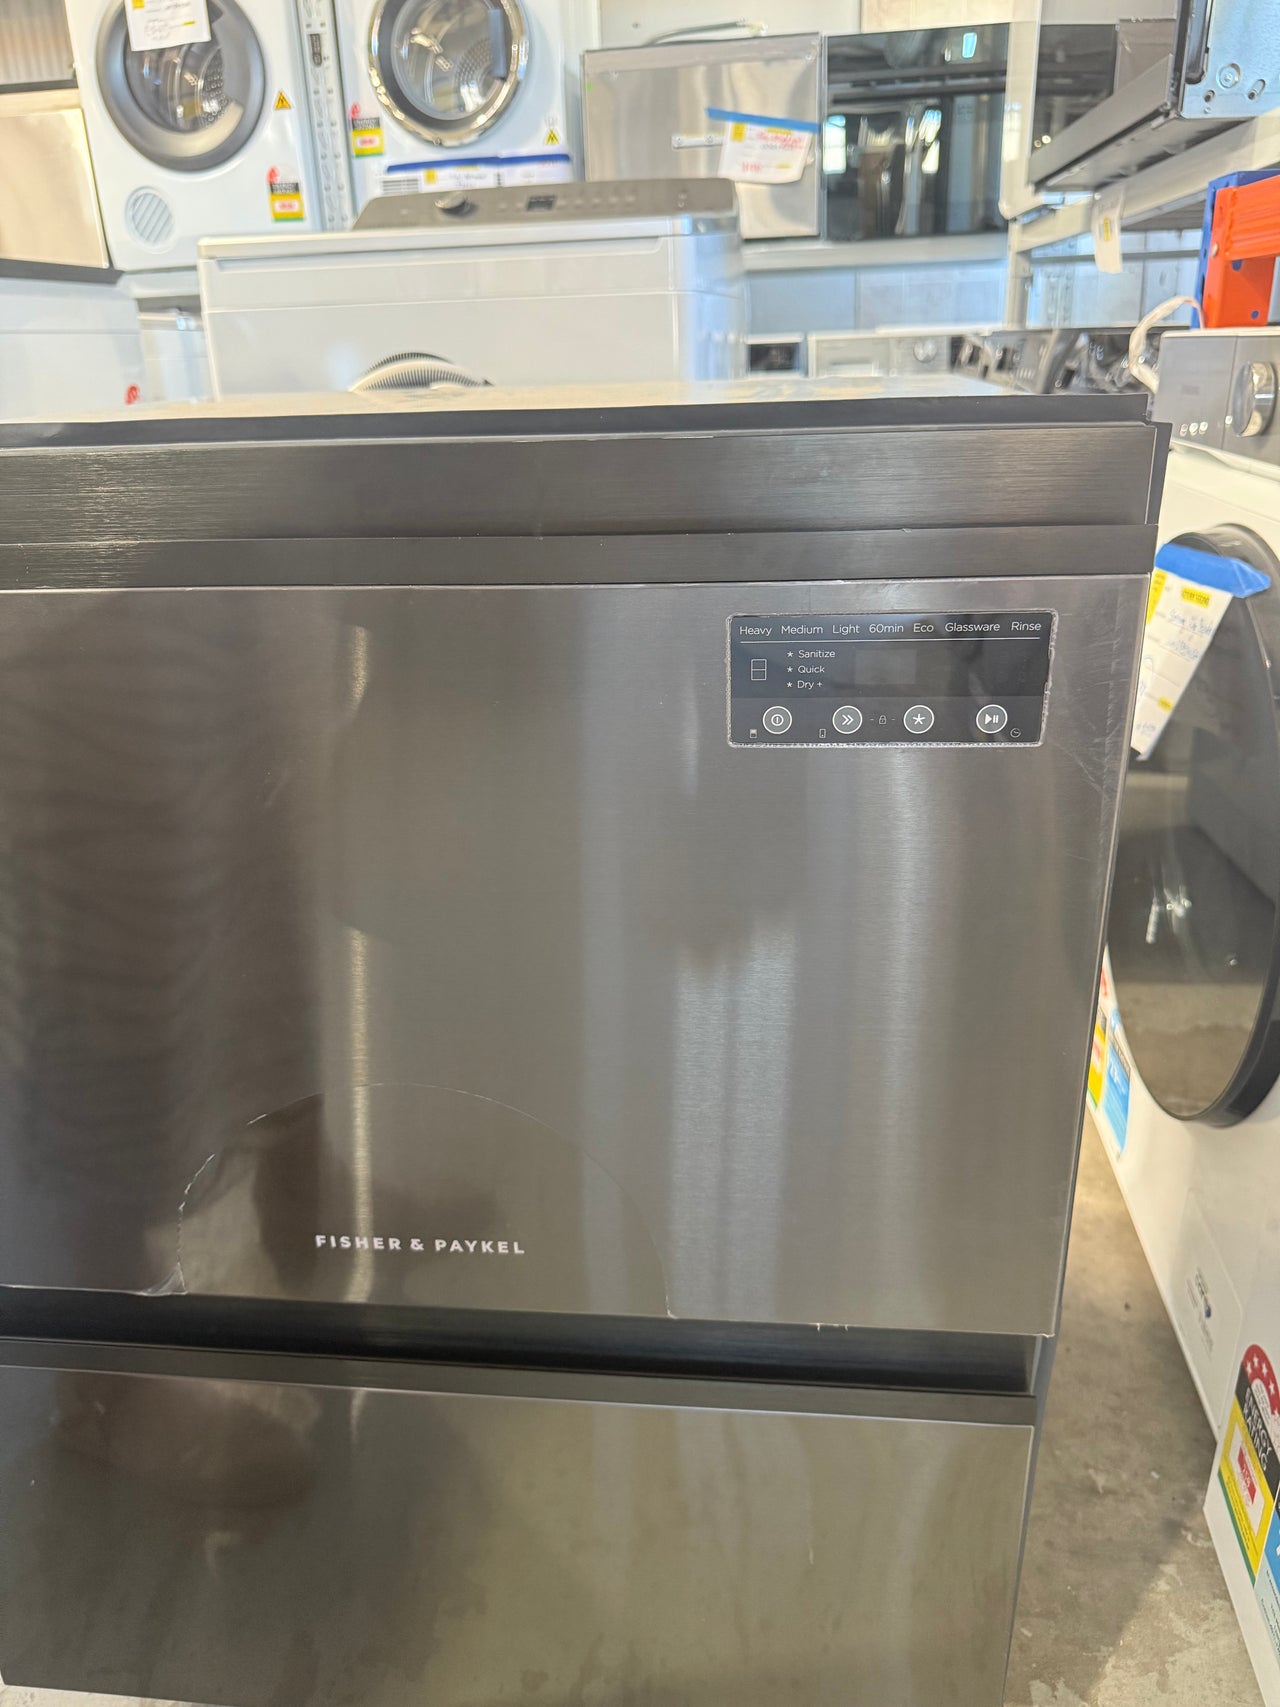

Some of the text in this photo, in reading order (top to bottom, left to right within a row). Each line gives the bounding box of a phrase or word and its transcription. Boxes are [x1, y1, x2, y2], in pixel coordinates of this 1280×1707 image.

[740, 621, 1042, 636] Heavy Medium Light 60min Eco Glassware Rinse
[798, 650, 836, 658] Sanitize
[797, 665, 825, 674] Quick
[797, 680, 814, 689] Dry
[315, 1234, 525, 1254] FISHER & PAYKEL
[1245, 1387, 1272, 1455] ENERGY
[1243, 1403, 1267, 1471] RATING
